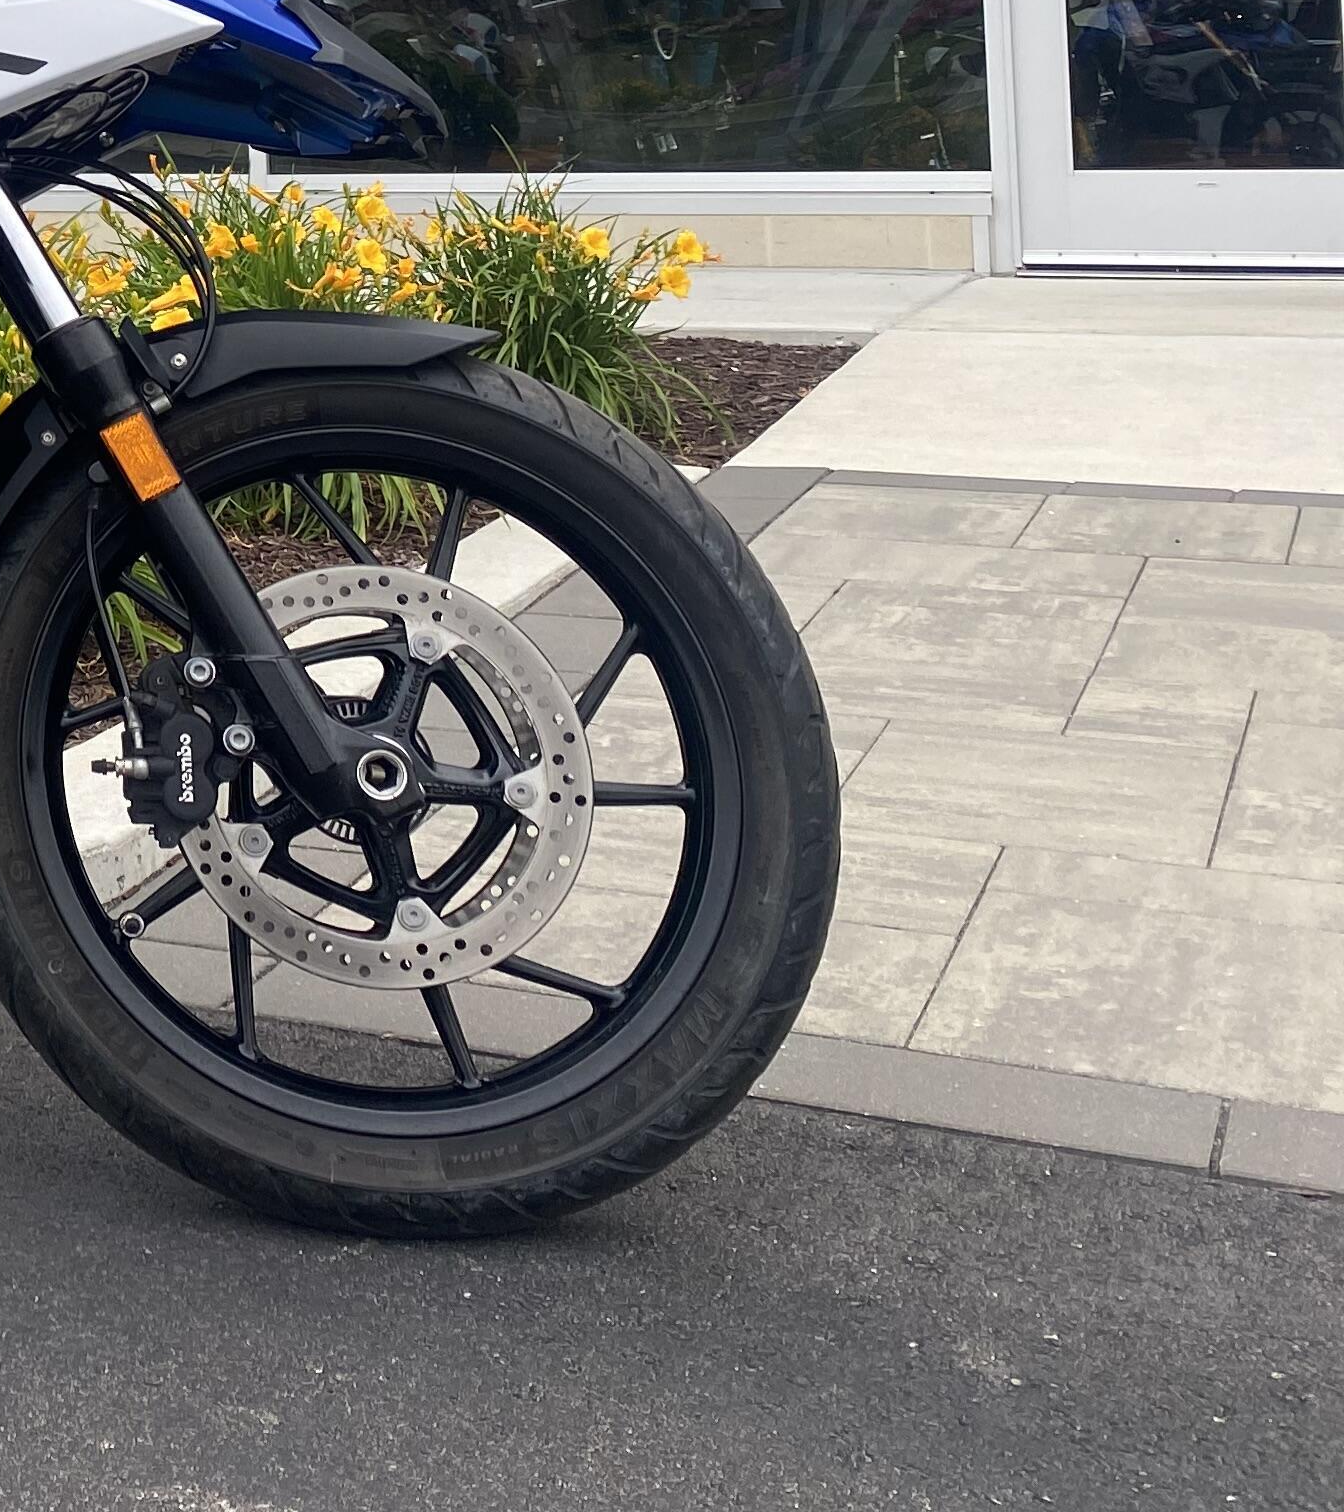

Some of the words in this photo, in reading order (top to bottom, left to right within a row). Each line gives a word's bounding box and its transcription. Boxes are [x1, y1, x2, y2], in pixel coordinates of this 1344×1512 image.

[176, 732, 194, 803] brembo
[531, 989, 725, 1156] MAXXIS
[451, 1143, 521, 1165] RADIAL
